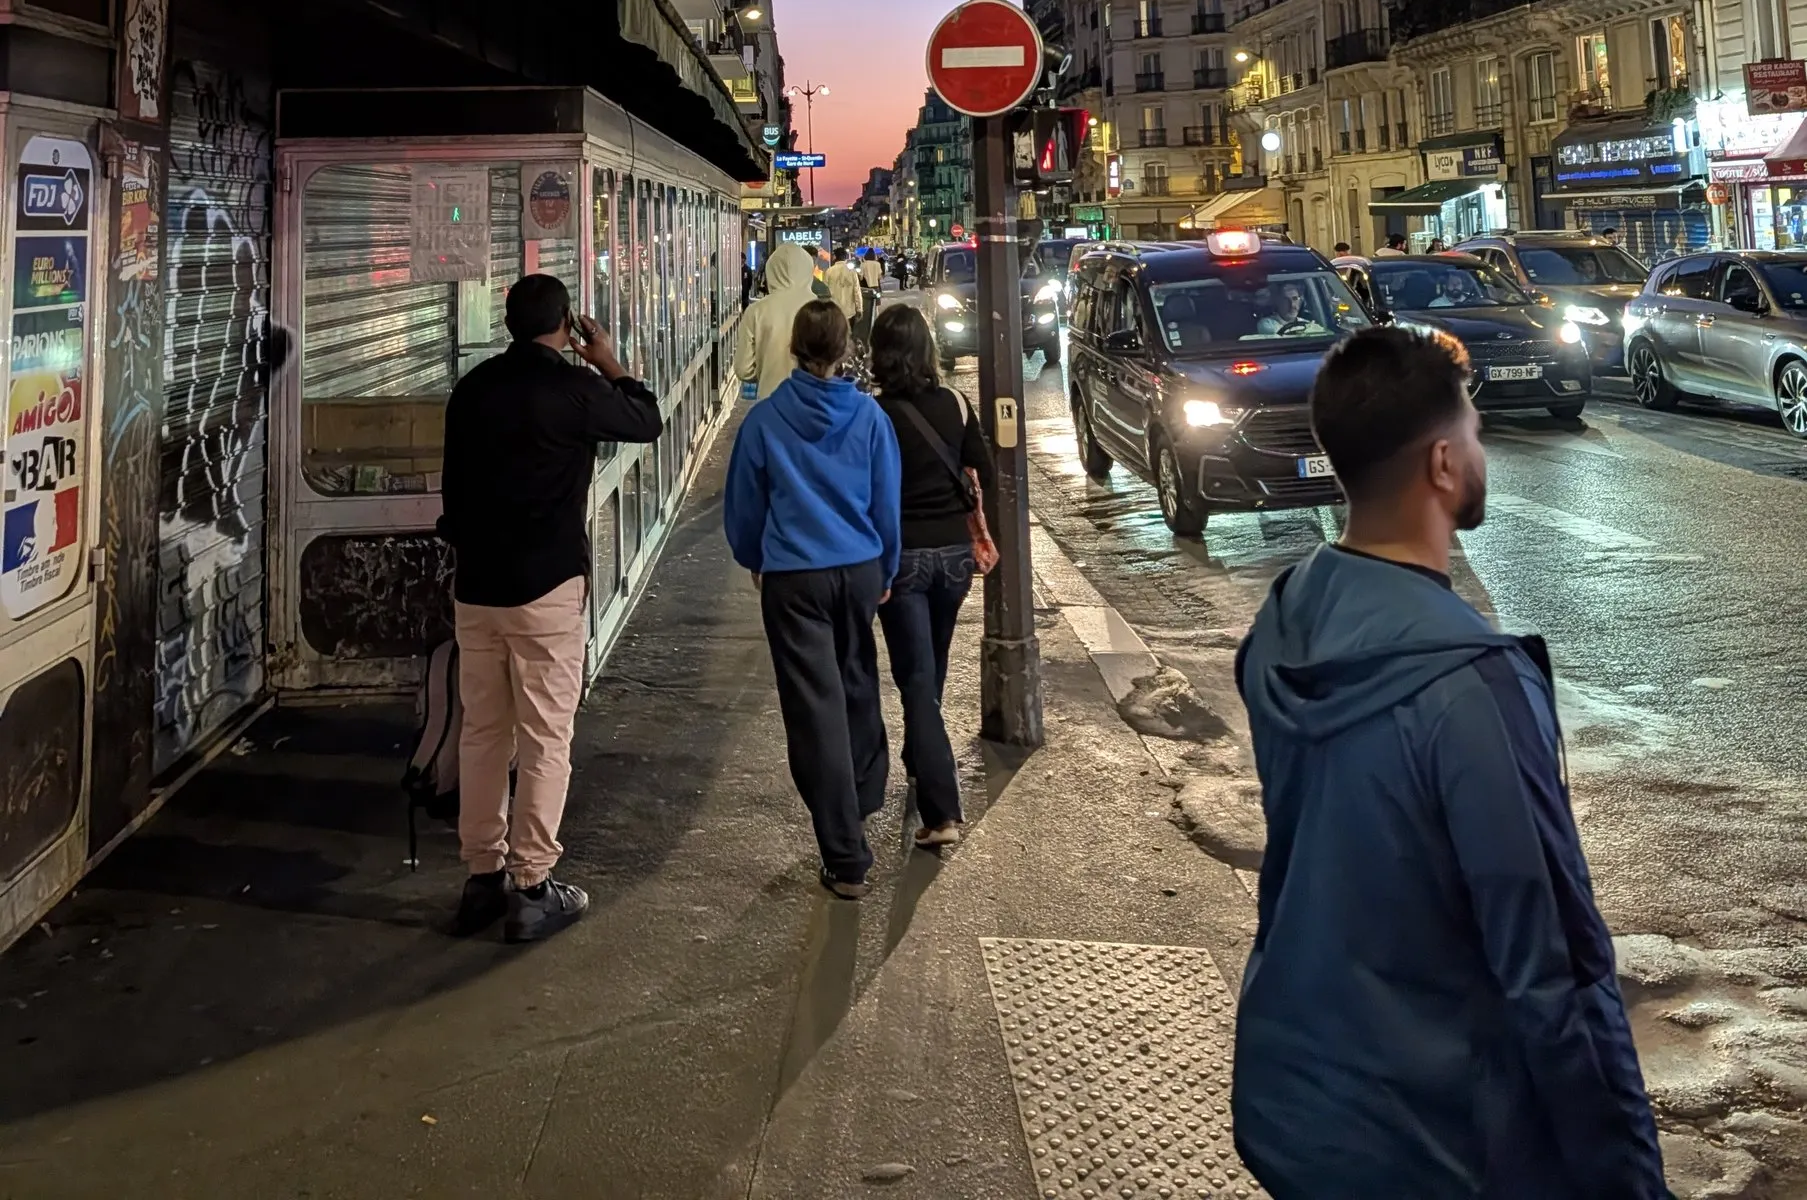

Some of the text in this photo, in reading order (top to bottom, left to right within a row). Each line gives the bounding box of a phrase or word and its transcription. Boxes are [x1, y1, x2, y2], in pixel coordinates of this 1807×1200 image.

[1752, 69, 1800, 79] RESTAURANT
[764, 127, 779, 136] BUS
[27, 183, 57, 208] FDJ
[1610, 196, 1656, 204] SERVICES
[33, 257, 55, 271] EURO
[31, 270, 67, 285] MILLIONS
[12, 329, 65, 361] PARIONS
[1490, 367, 1537, 379] GX-799-NF
[20, 436, 77, 492] BAR
[17, 564, 40, 582] Timbre
[20, 564, 62, 594] Timbre fiscal
